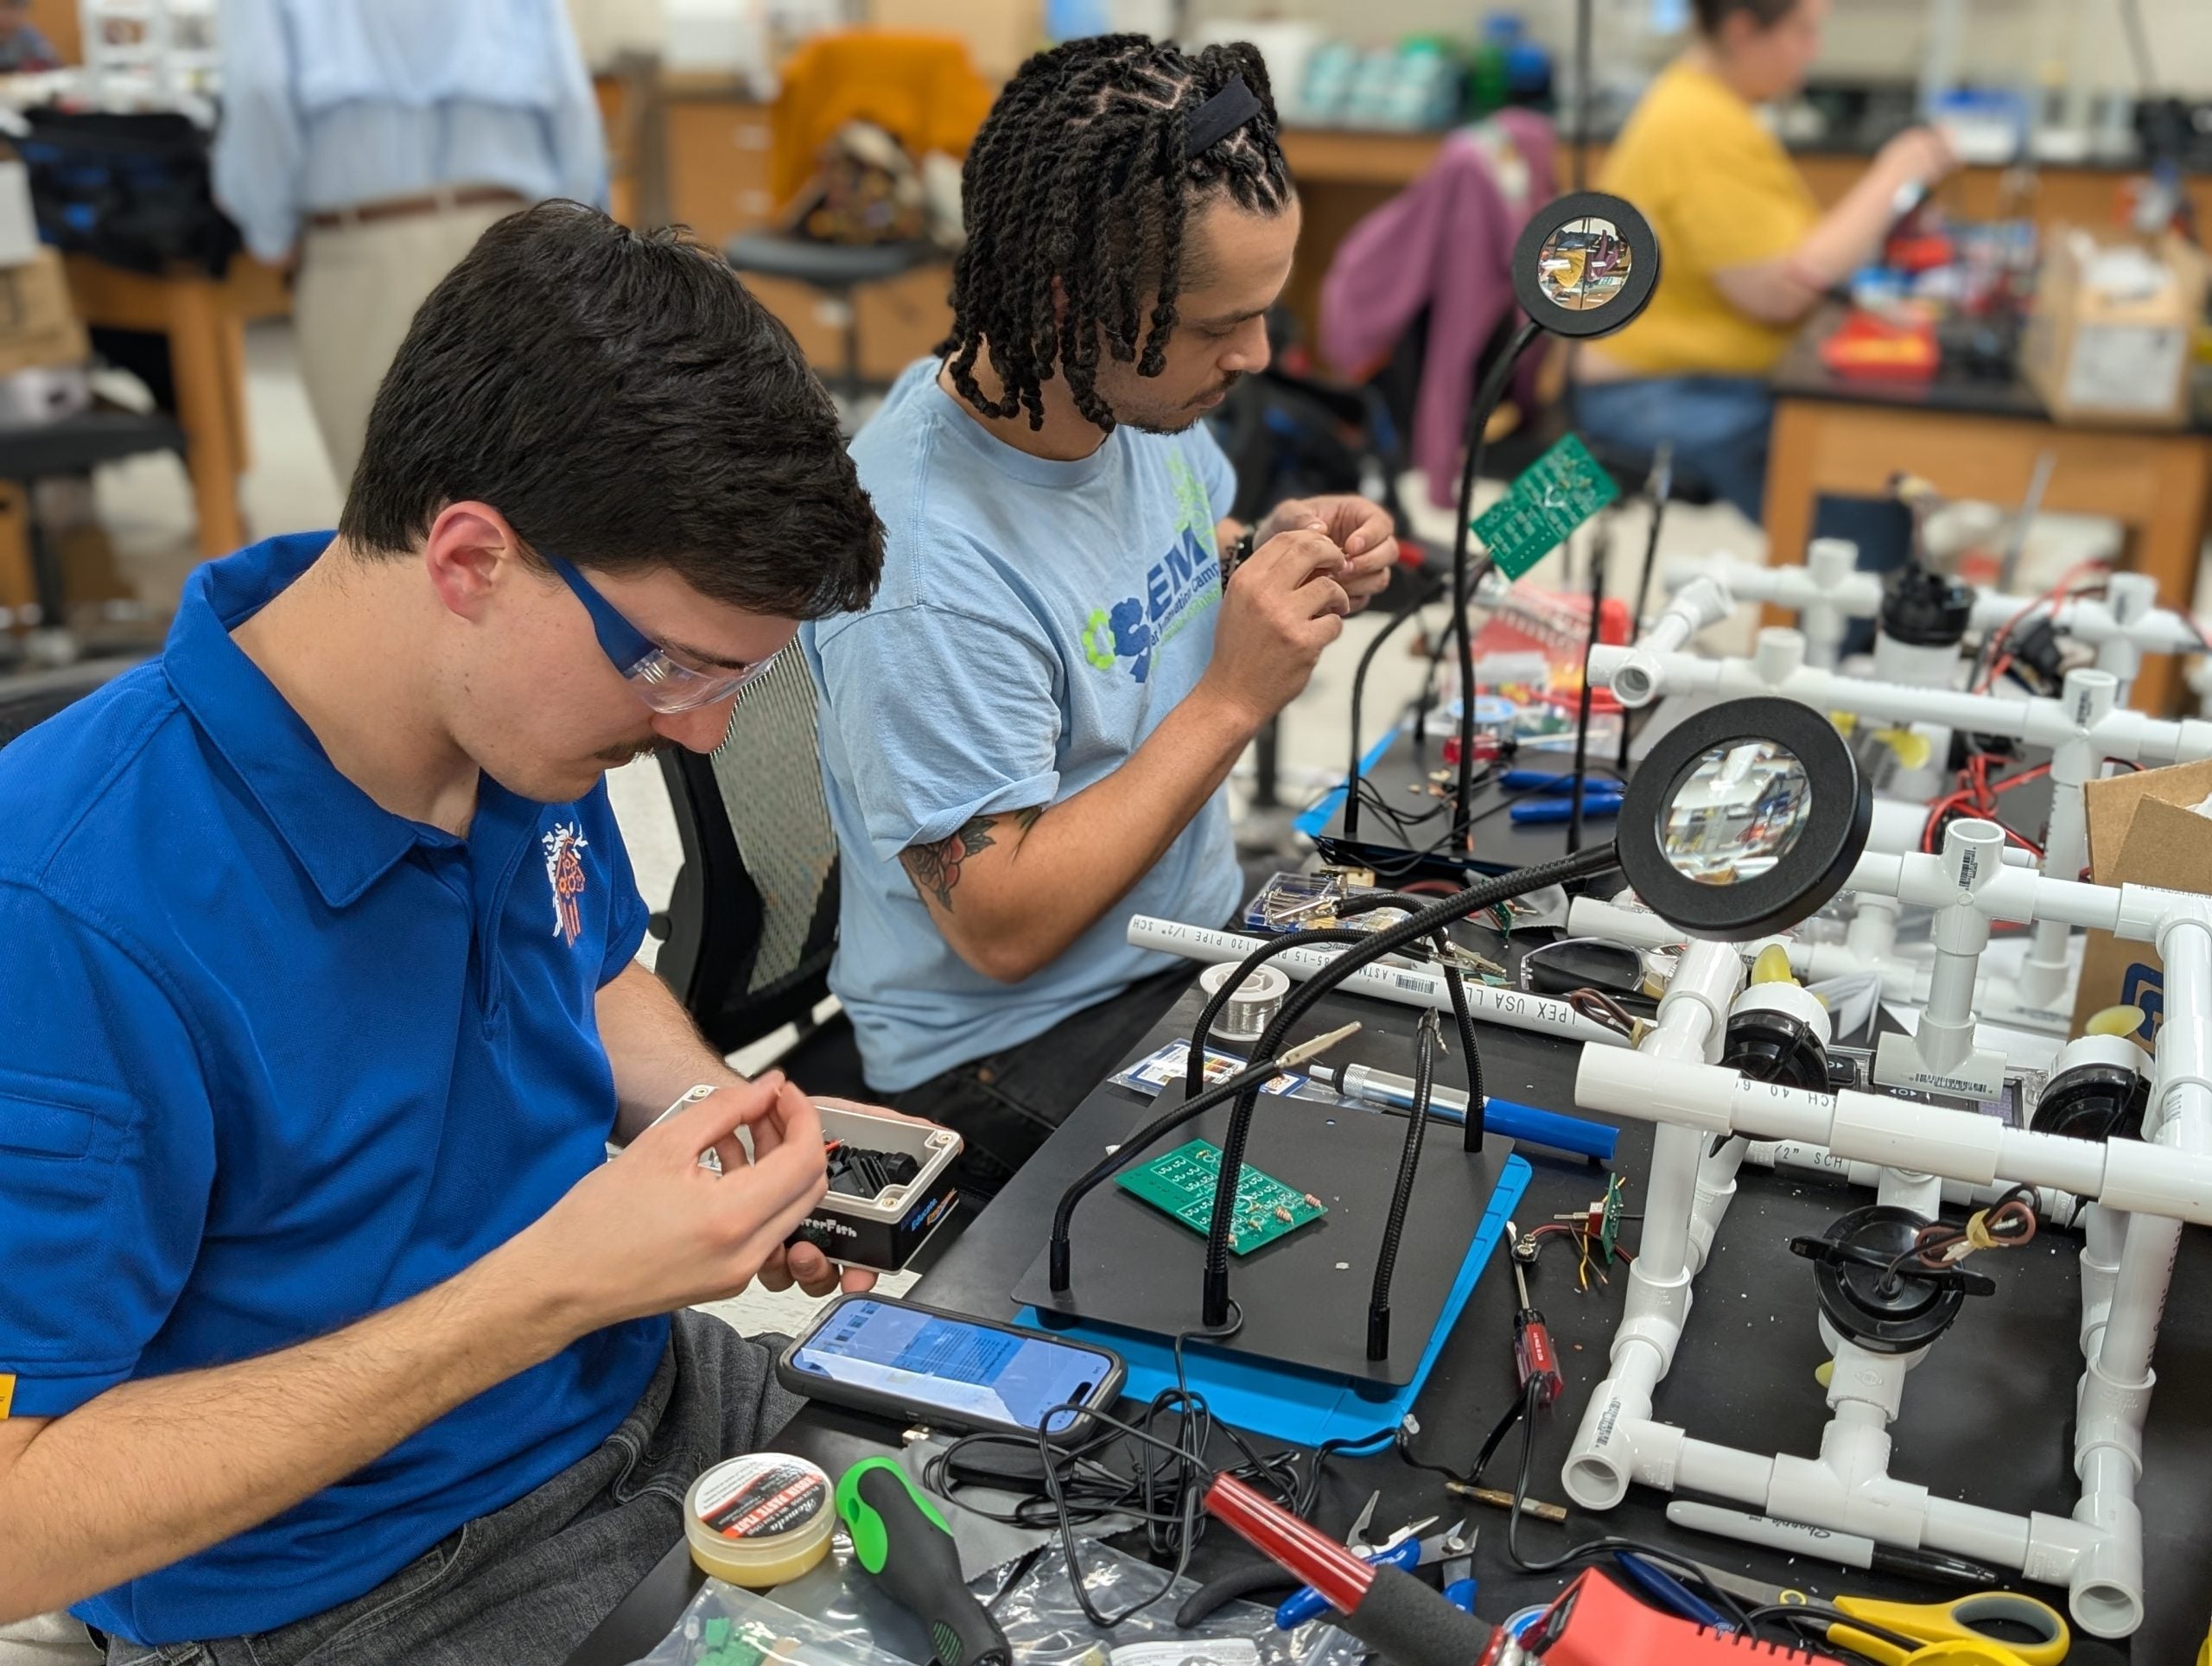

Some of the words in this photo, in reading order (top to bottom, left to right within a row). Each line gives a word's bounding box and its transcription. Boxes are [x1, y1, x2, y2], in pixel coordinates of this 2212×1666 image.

[1132, 917, 1154, 932] SCH
[1195, 931, 1223, 946] PIPE
[1294, 951, 1332, 967] 85-15
[1495, 992, 1525, 1014] USA
[1538, 1002, 1577, 1026] IPEX
[1770, 1084, 1790, 1098] 40
[1814, 1152, 1843, 1169] SCH
